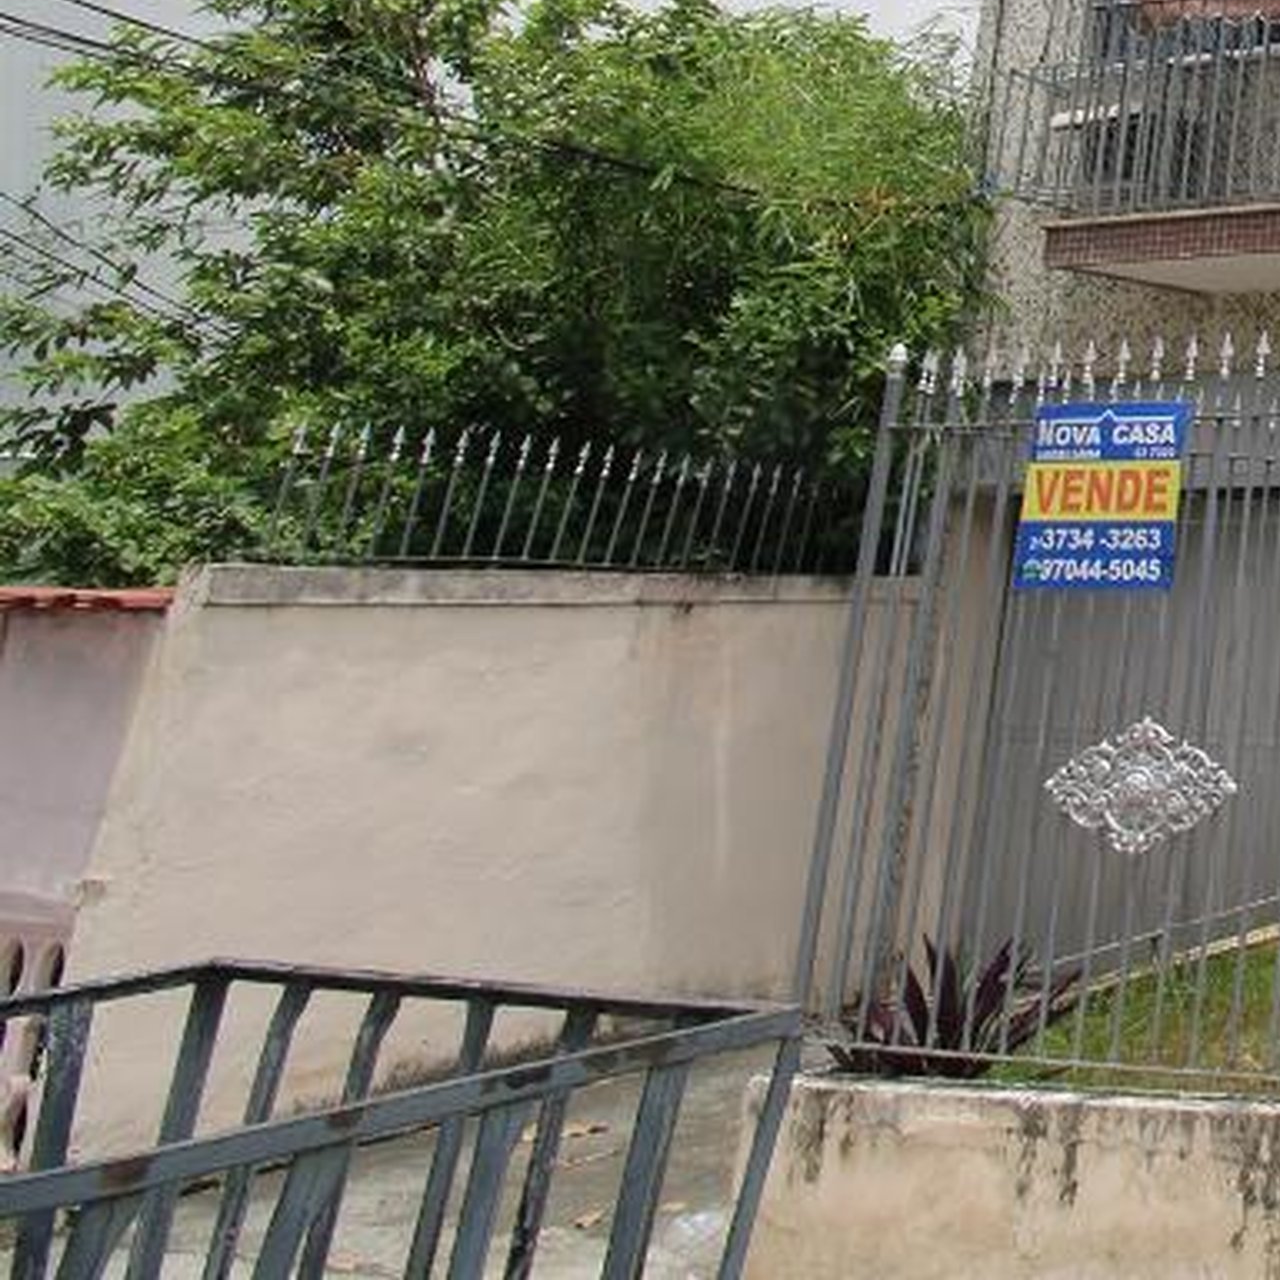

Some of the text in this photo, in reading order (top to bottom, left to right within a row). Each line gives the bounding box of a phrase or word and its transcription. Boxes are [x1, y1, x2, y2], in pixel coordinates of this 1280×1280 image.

[1038, 421, 1176, 446] NOVA CASA
[1035, 469, 1172, 514] VENDE
